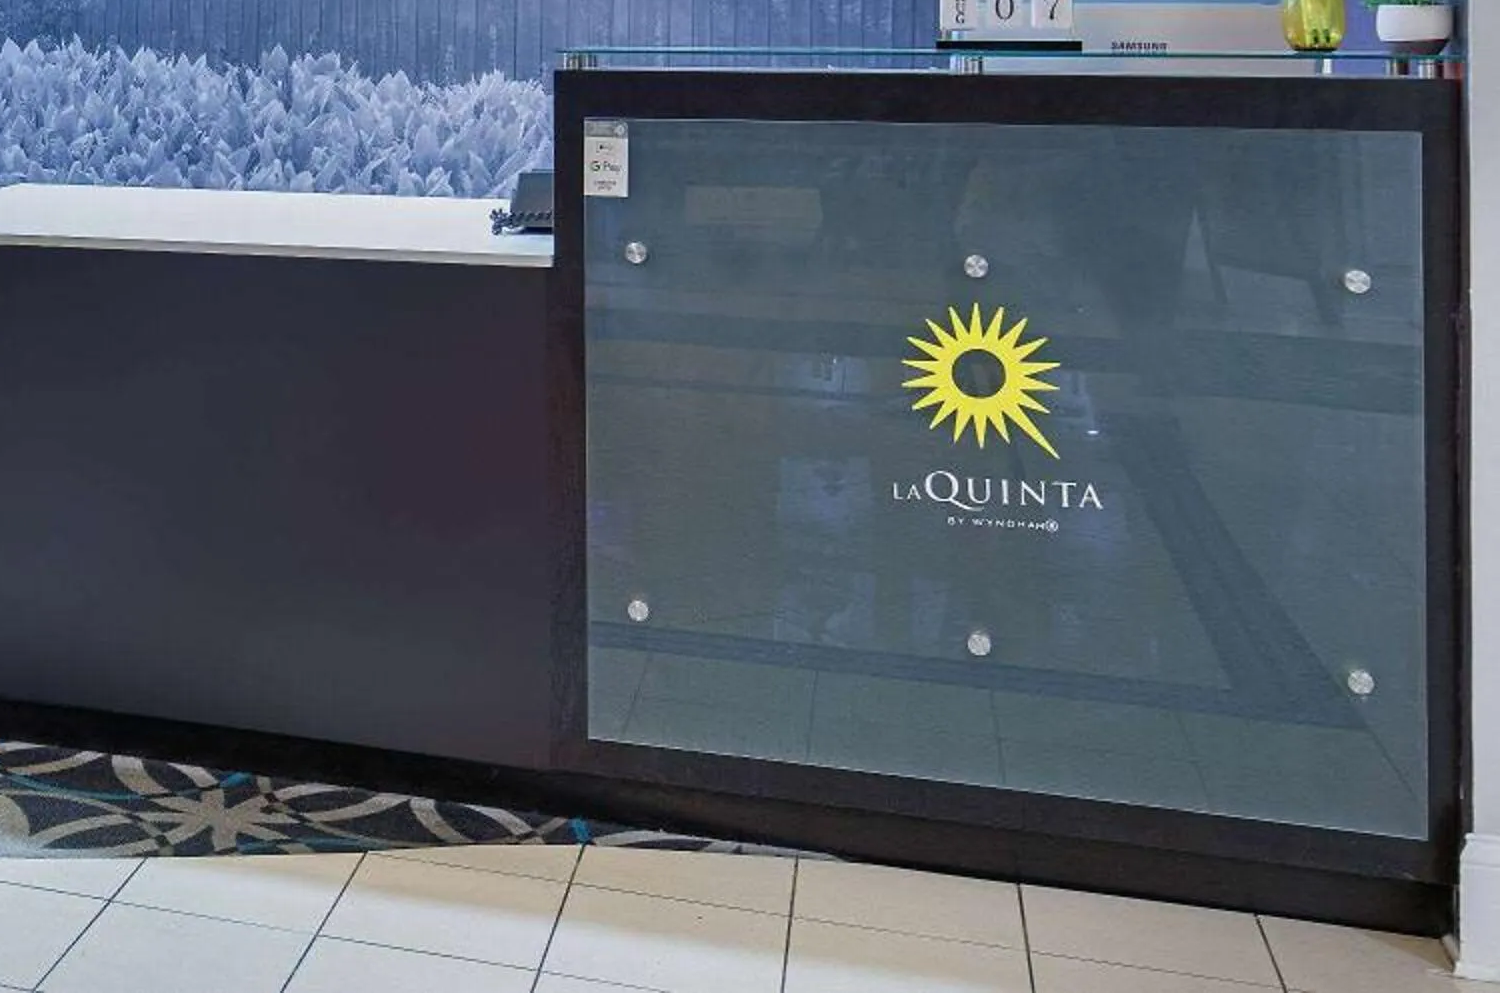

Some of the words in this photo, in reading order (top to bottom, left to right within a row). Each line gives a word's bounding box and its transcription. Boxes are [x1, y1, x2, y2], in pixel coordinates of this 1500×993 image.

[1110, 41, 1168, 50] SAMSUNG
[892, 482, 921, 501] LA
[924, 470, 1104, 512] QUINTA
[946, 516, 965, 526] BY
